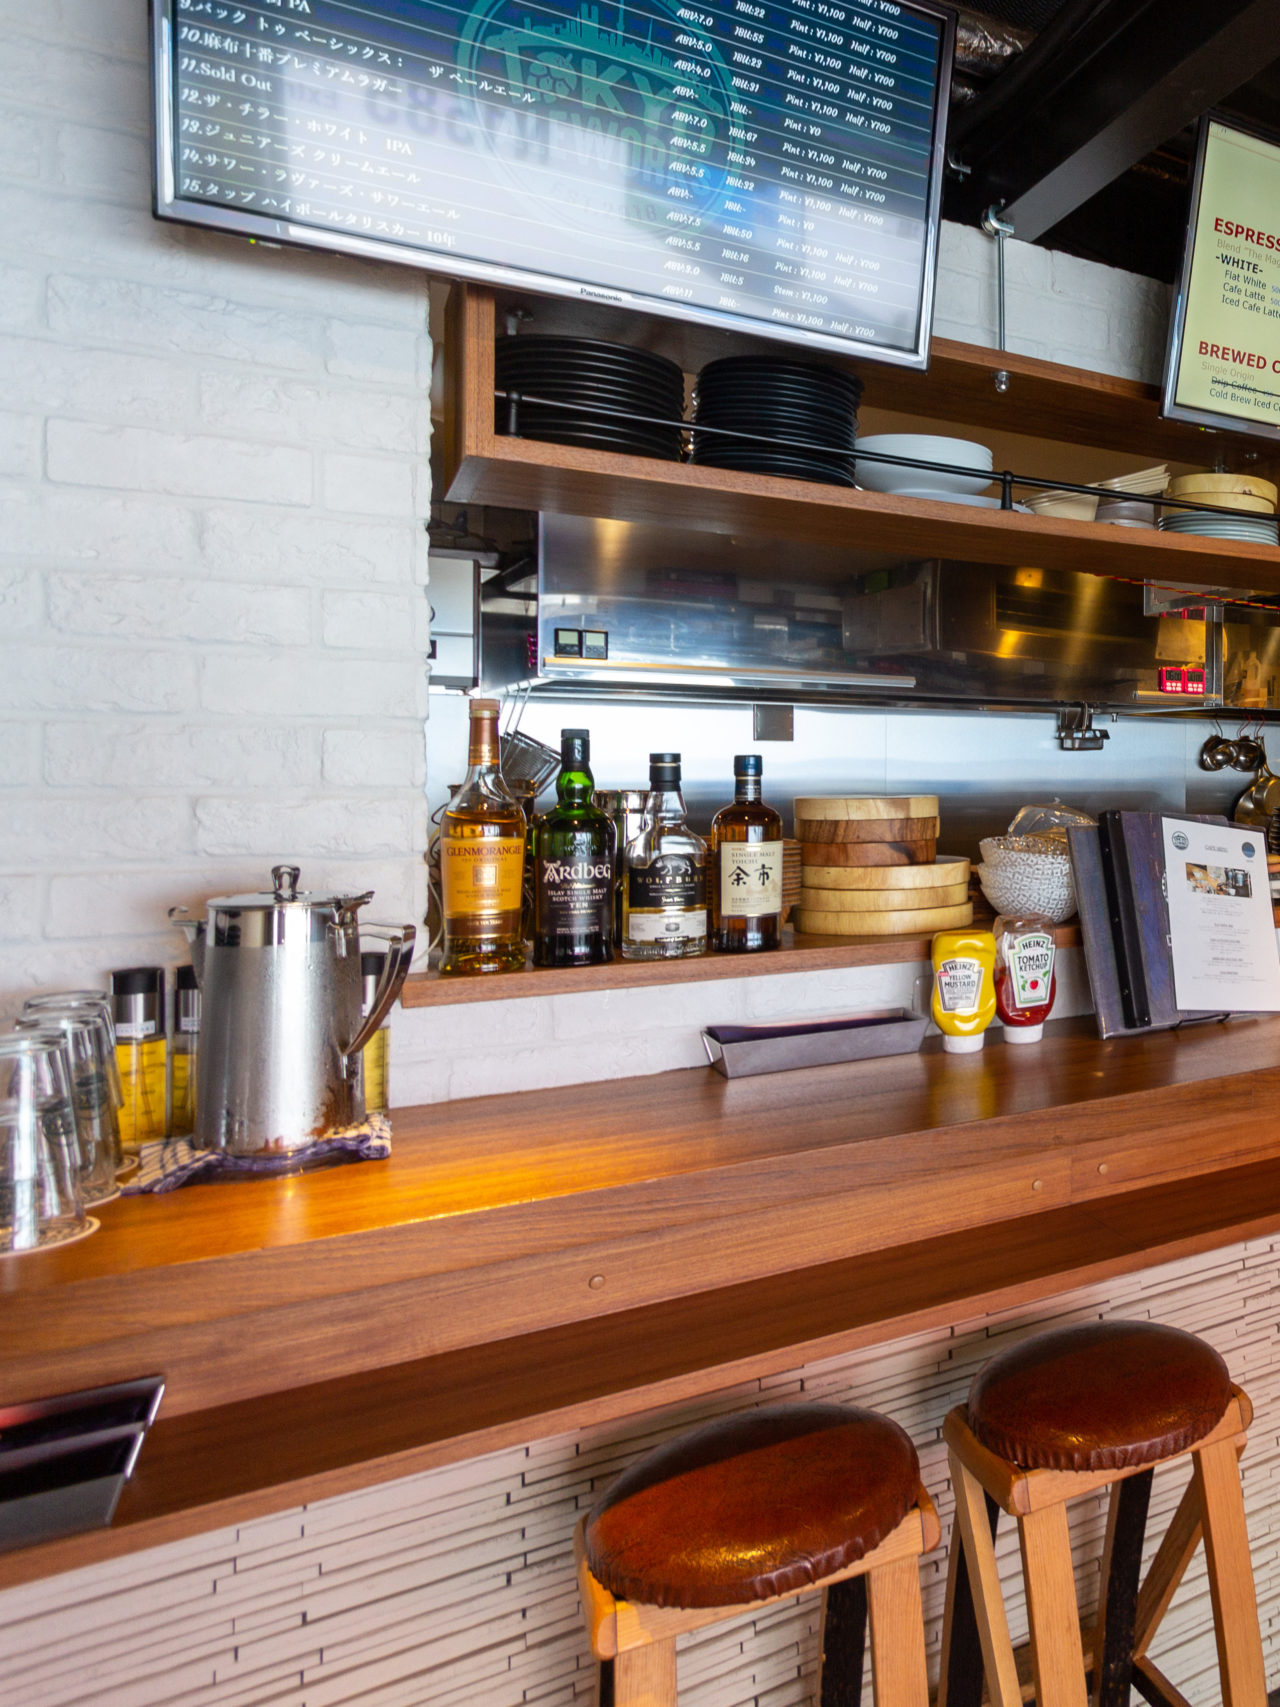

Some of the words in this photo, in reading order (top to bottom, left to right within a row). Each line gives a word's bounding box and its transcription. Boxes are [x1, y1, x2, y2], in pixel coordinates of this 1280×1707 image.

[676, 7, 714, 27] ABV:7.0
[852, 16, 872, 31] Half
[878, 25, 899, 40] ¥700
[675, 33, 713, 53] ABV:5.0
[790, 19, 808, 34] Pint
[850, 40, 871, 56] Half
[876, 49, 897, 64] ¥700
[673, 59, 711, 78] ABV:4.0
[788, 44, 807, 59] Pint
[848, 64, 869, 79] Half
[874, 73, 895, 88] ¥700
[241, 73, 273, 92] Out
[787, 69, 805, 83] Pint
[847, 88, 867, 103] Half
[872, 96, 893, 111] ¥700
[672, 85, 699, 100] ABV:-
[729, 101, 753, 116] IBU:-
[671, 110, 708, 129] ABV:7.0
[785, 93, 804, 108] Pint
[845, 112, 865, 127] Half
[870, 119, 891, 134] ¥700
[784, 118, 802, 131] Pint
[669, 136, 707, 154] ABV:5.5
[668, 161, 705, 178] ABV:5.5
[782, 142, 801, 156] Pint
[841, 159, 862, 174] Half
[866, 166, 888, 181] ¥700
[781, 166, 799, 180] Pint
[840, 183, 860, 198] Half
[865, 190, 886, 204] ¥700
[1216, 238, 1241, 254] Blend
[1215, 253, 1264, 275] -WHITE-
[1224, 269, 1241, 283] Flat
[1243, 275, 1267, 291] White
[580, 287, 623, 302] Panasonic
[1223, 282, 1242, 296] Cafe
[1244, 288, 1266, 303] Latte
[1221, 294, 1240, 308] Iced
[1242, 299, 1261, 313] Cafe
[1198, 340, 1267, 370] BREWED
[1209, 388, 1228, 400] Cold
[1230, 392, 1252, 405] Brew
[1253, 397, 1271, 410] Iced
[446, 845, 522, 857] GLENMORANGIE
[728, 863, 773, 887] 余市
[1021, 939, 1046, 951] HEINZ
[948, 962, 973, 972] HEINZ
[1017, 953, 1050, 966] TOMATO
[1019, 962, 1048, 973] KETCHUP
